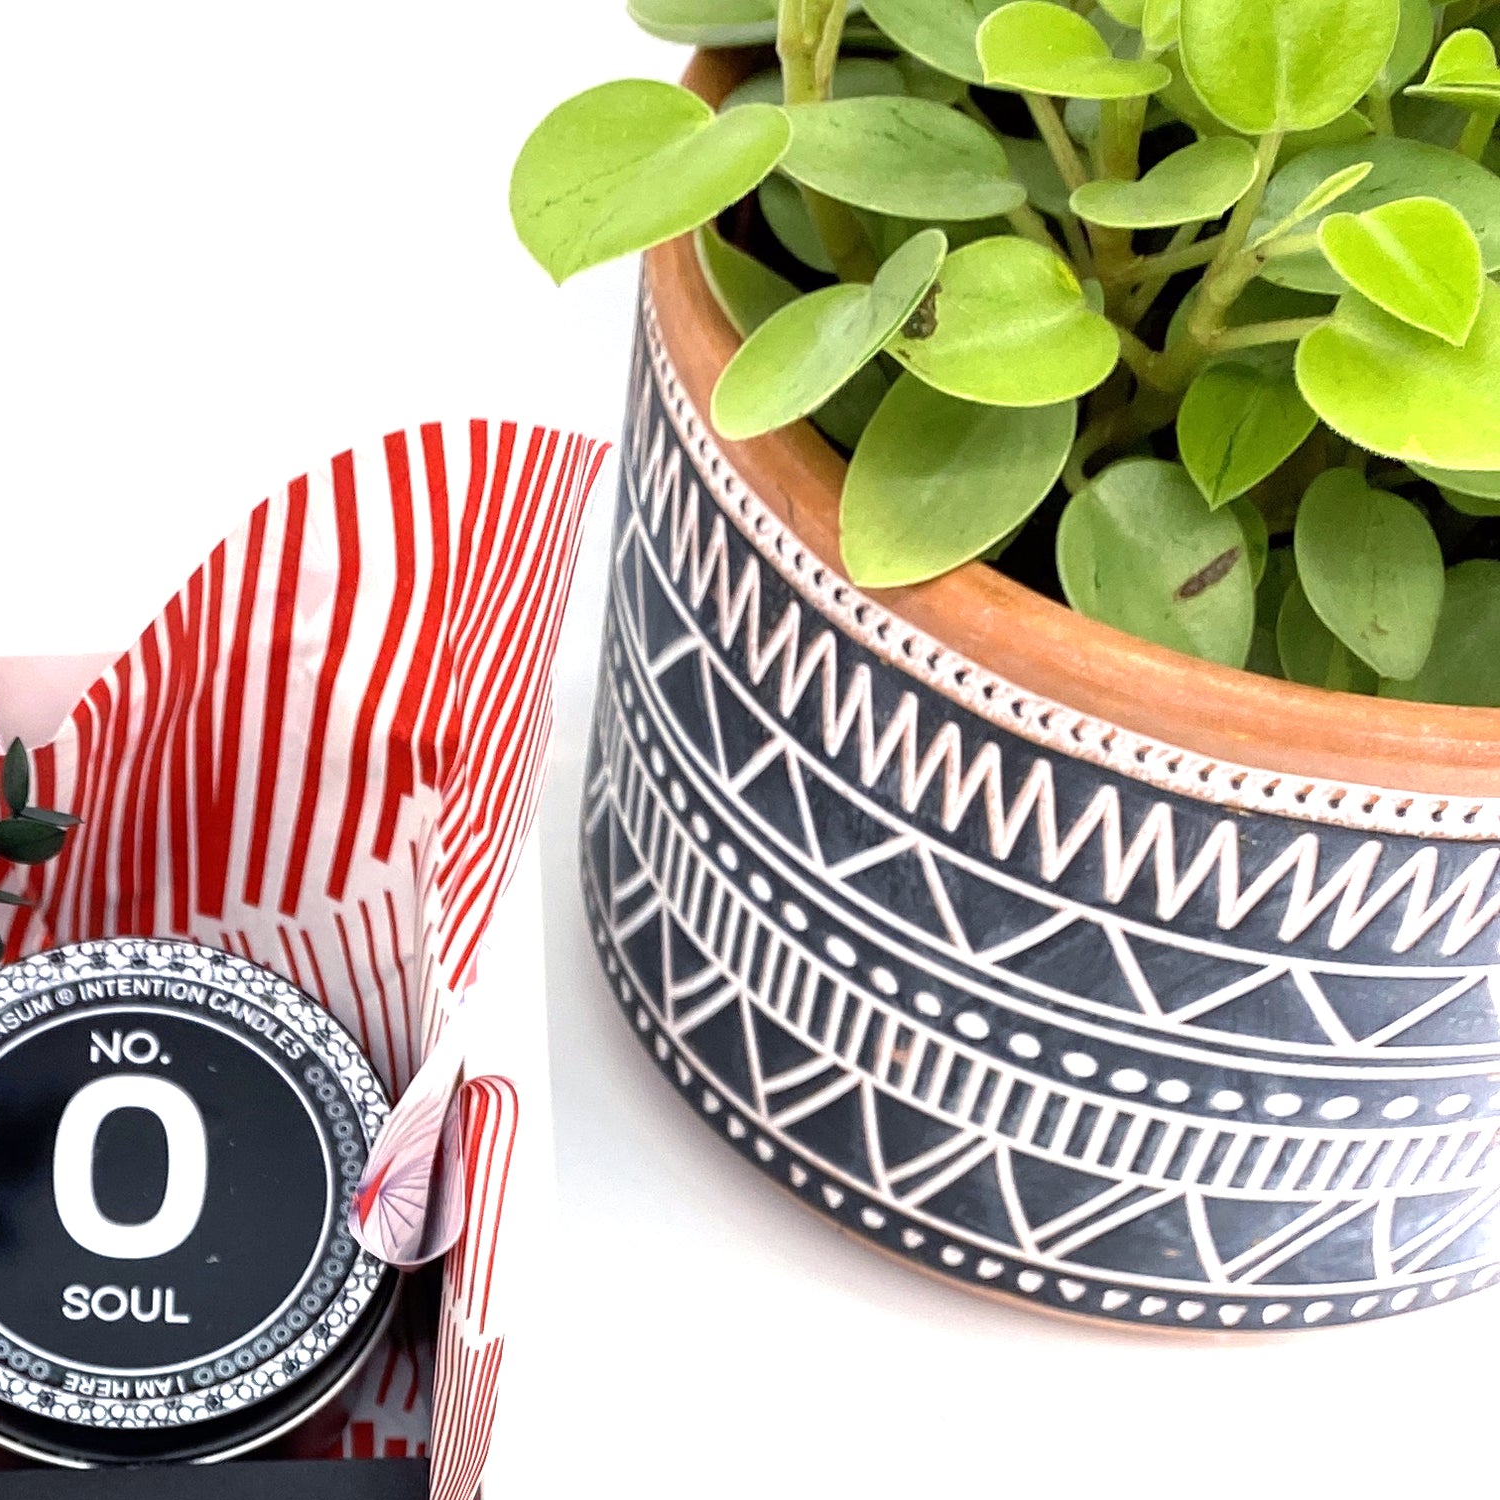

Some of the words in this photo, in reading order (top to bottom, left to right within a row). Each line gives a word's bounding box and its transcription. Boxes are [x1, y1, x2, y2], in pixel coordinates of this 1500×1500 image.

[79, 978, 207, 1005] INTENTION
[209, 991, 305, 1060] CANDLES
[89, 1030, 171, 1065] NO.
[61, 1284, 190, 1325] SOUL
[62, 1371, 130, 1399] HERE
[134, 1376, 173, 1399] AM
[176, 1374, 186, 1393] I
